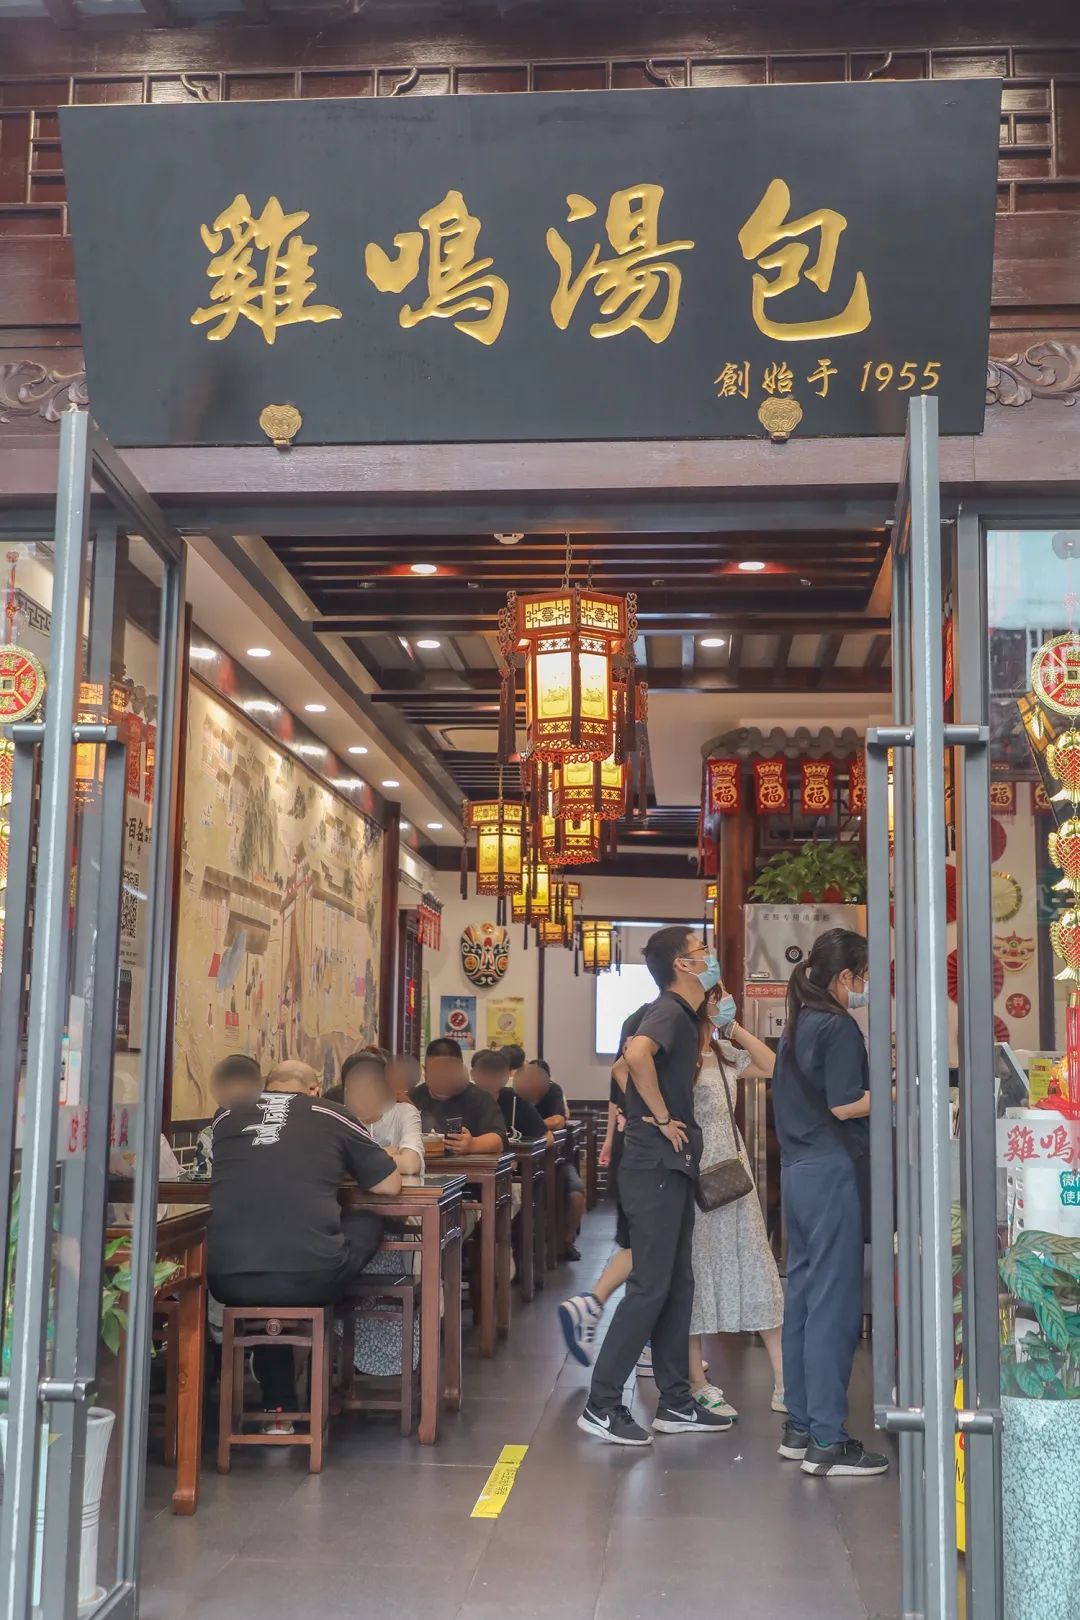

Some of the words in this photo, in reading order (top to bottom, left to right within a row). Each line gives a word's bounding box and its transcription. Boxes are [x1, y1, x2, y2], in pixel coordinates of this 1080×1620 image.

[190, 178, 872, 345] 雞鳴湯包
[714, 359, 839, 399] 創始于
[860, 360, 941, 392] 1955
[714, 786, 734, 802] 福
[762, 786, 784, 802] 福
[807, 786, 825, 803] 福
[1003, 1125, 1080, 1163] 雞鳴
[1063, 1174, 1080, 1187] 微
[1064, 1191, 1080, 1204] 使
